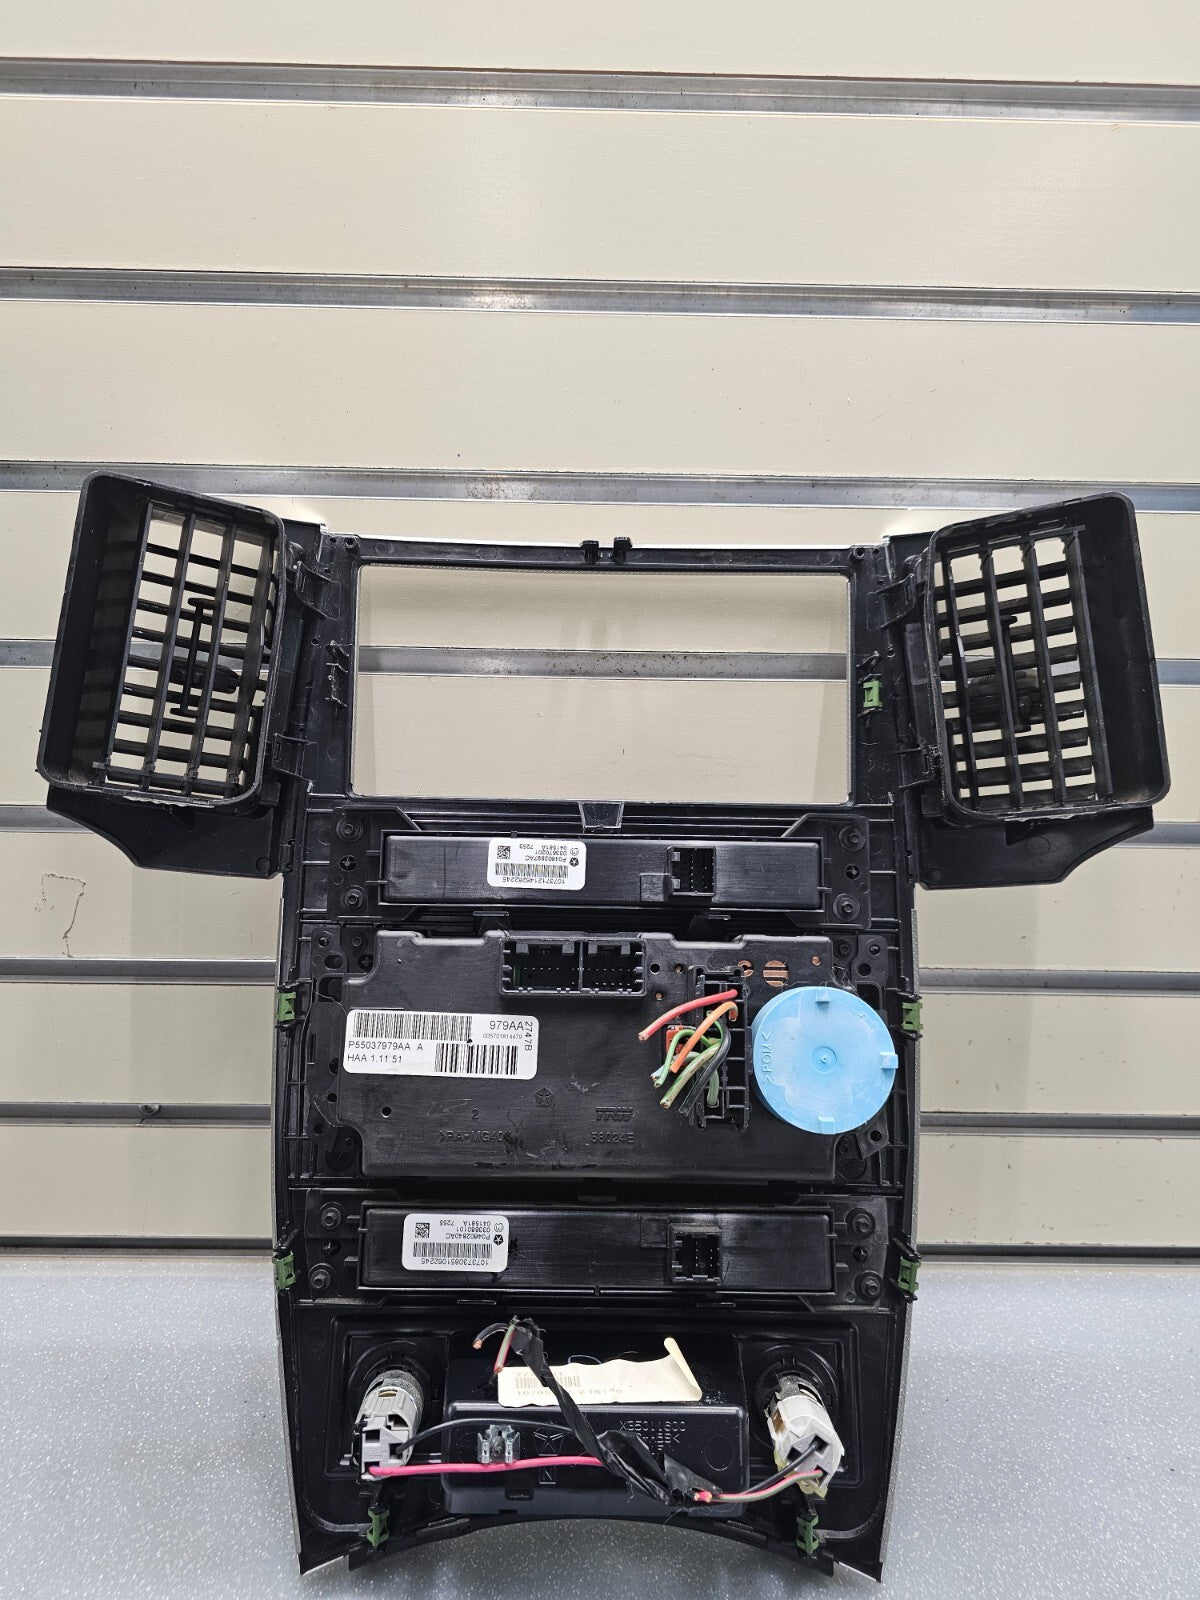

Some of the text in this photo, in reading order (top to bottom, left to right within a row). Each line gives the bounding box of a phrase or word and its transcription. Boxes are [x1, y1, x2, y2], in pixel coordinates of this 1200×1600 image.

[489, 1020, 524, 1031] 979AA
[524, 1021, 533, 1052] 2747B
[348, 1040, 423, 1051] P55037979AA A
[347, 1054, 402, 1064] HAA 1.11.51
